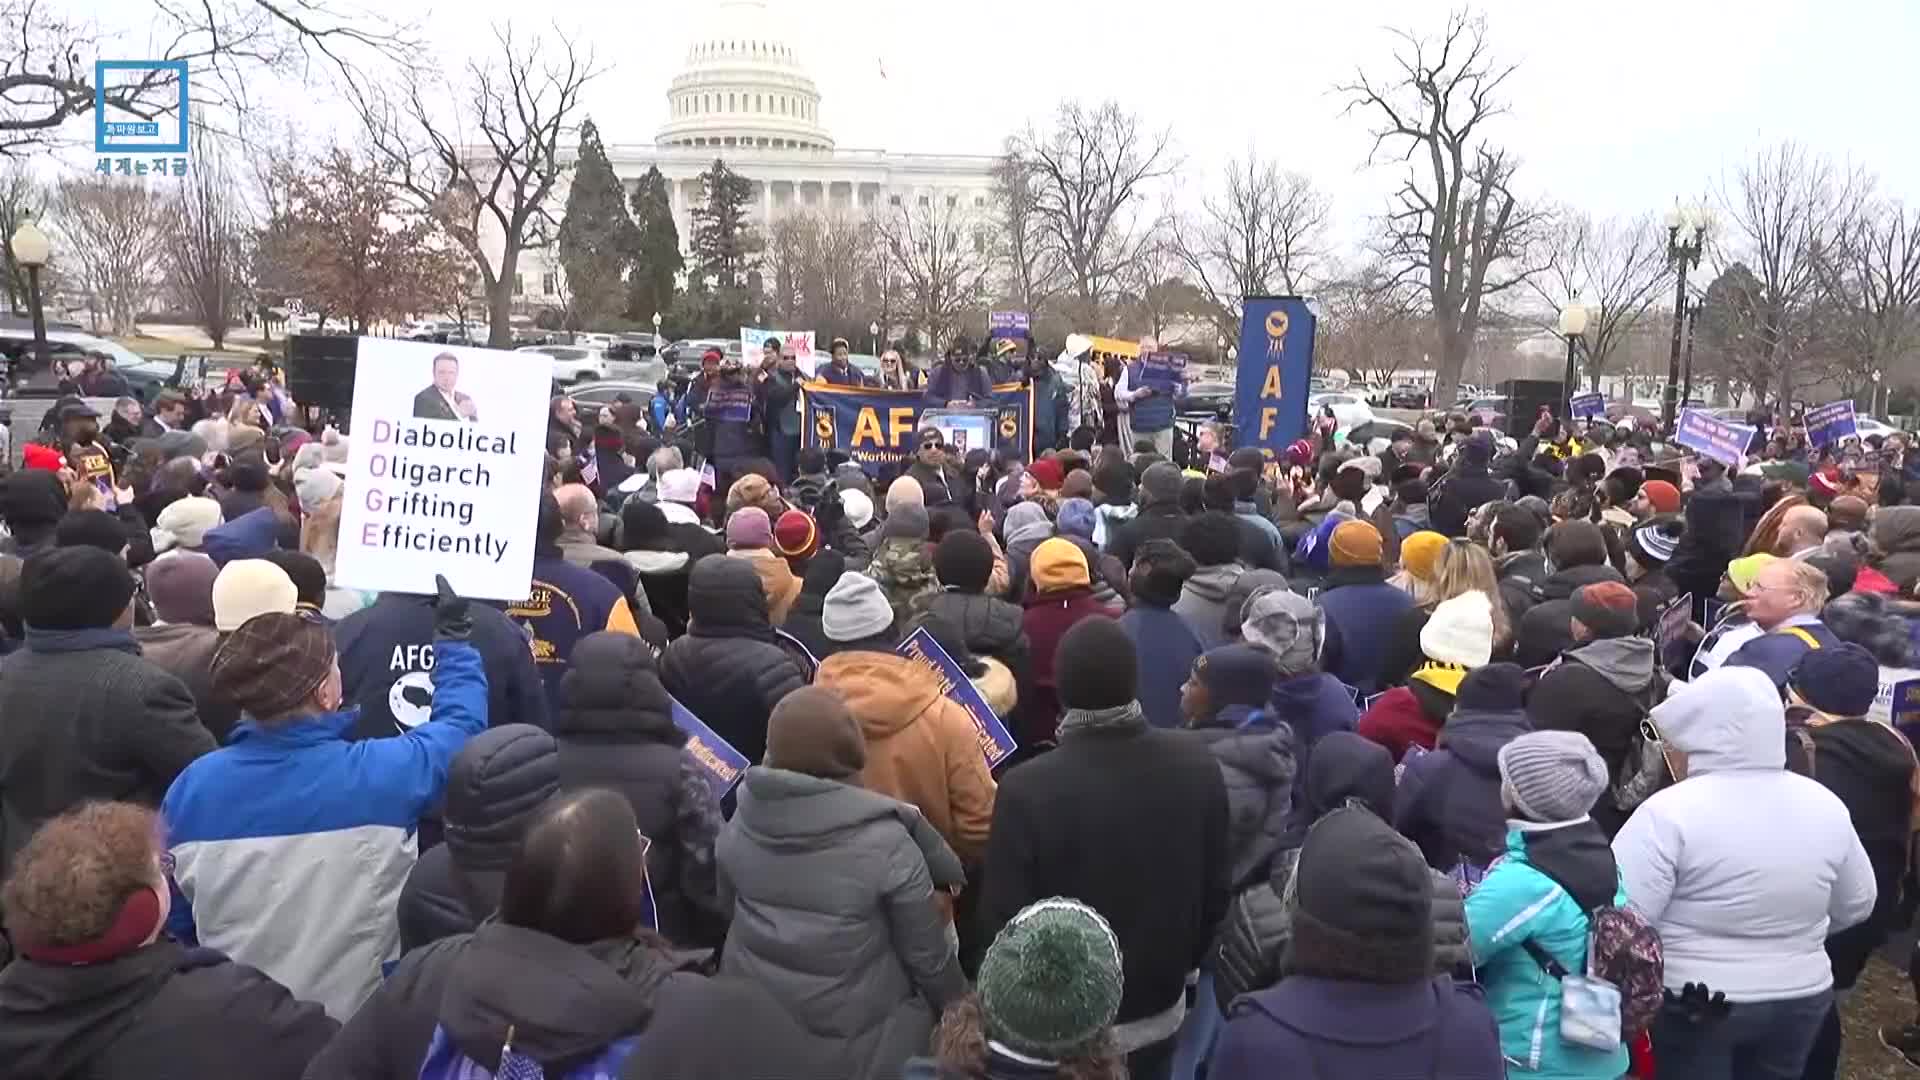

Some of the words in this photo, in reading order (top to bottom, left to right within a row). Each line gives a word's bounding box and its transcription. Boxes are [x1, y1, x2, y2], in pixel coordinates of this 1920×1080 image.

[373, 420, 516, 454] Diabolical
[850, 407, 914, 447] AF
[370, 454, 490, 487] Oligarch
[366, 488, 473, 526] Grifting
[362, 522, 508, 563] Efficiently
[389, 644, 435, 671] AFG
